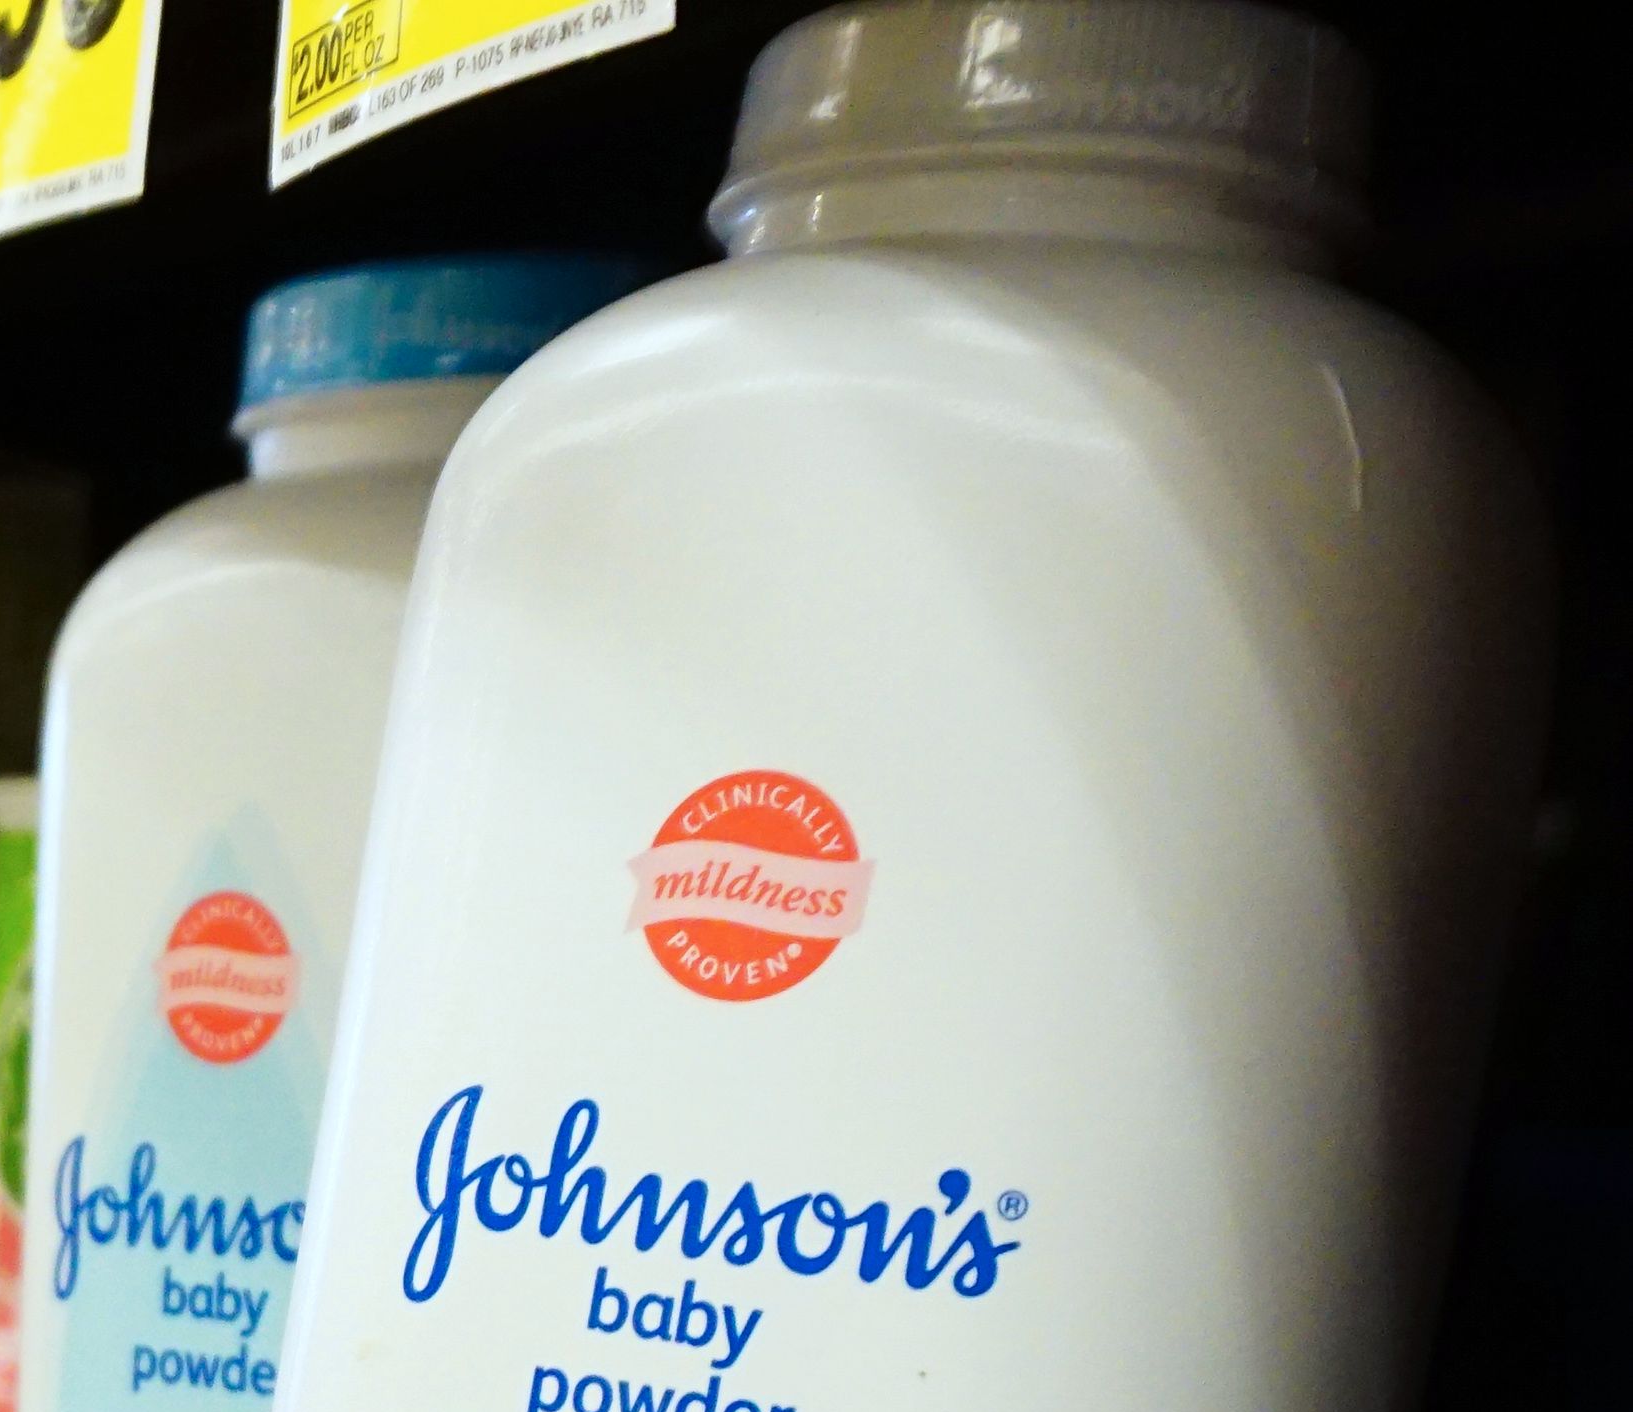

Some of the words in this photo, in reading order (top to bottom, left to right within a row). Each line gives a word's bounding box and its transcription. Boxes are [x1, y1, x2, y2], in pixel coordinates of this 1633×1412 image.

[342, 48, 358, 81] FL
[363, 34, 386, 69] OZ
[344, 10, 375, 47] PER
[680, 781, 845, 854] CLINICALLY
[652, 859, 848, 917] mildness
[170, 960, 286, 996] mildness
[162, 1265, 269, 1338] baby
[586, 1265, 764, 1370] baby
